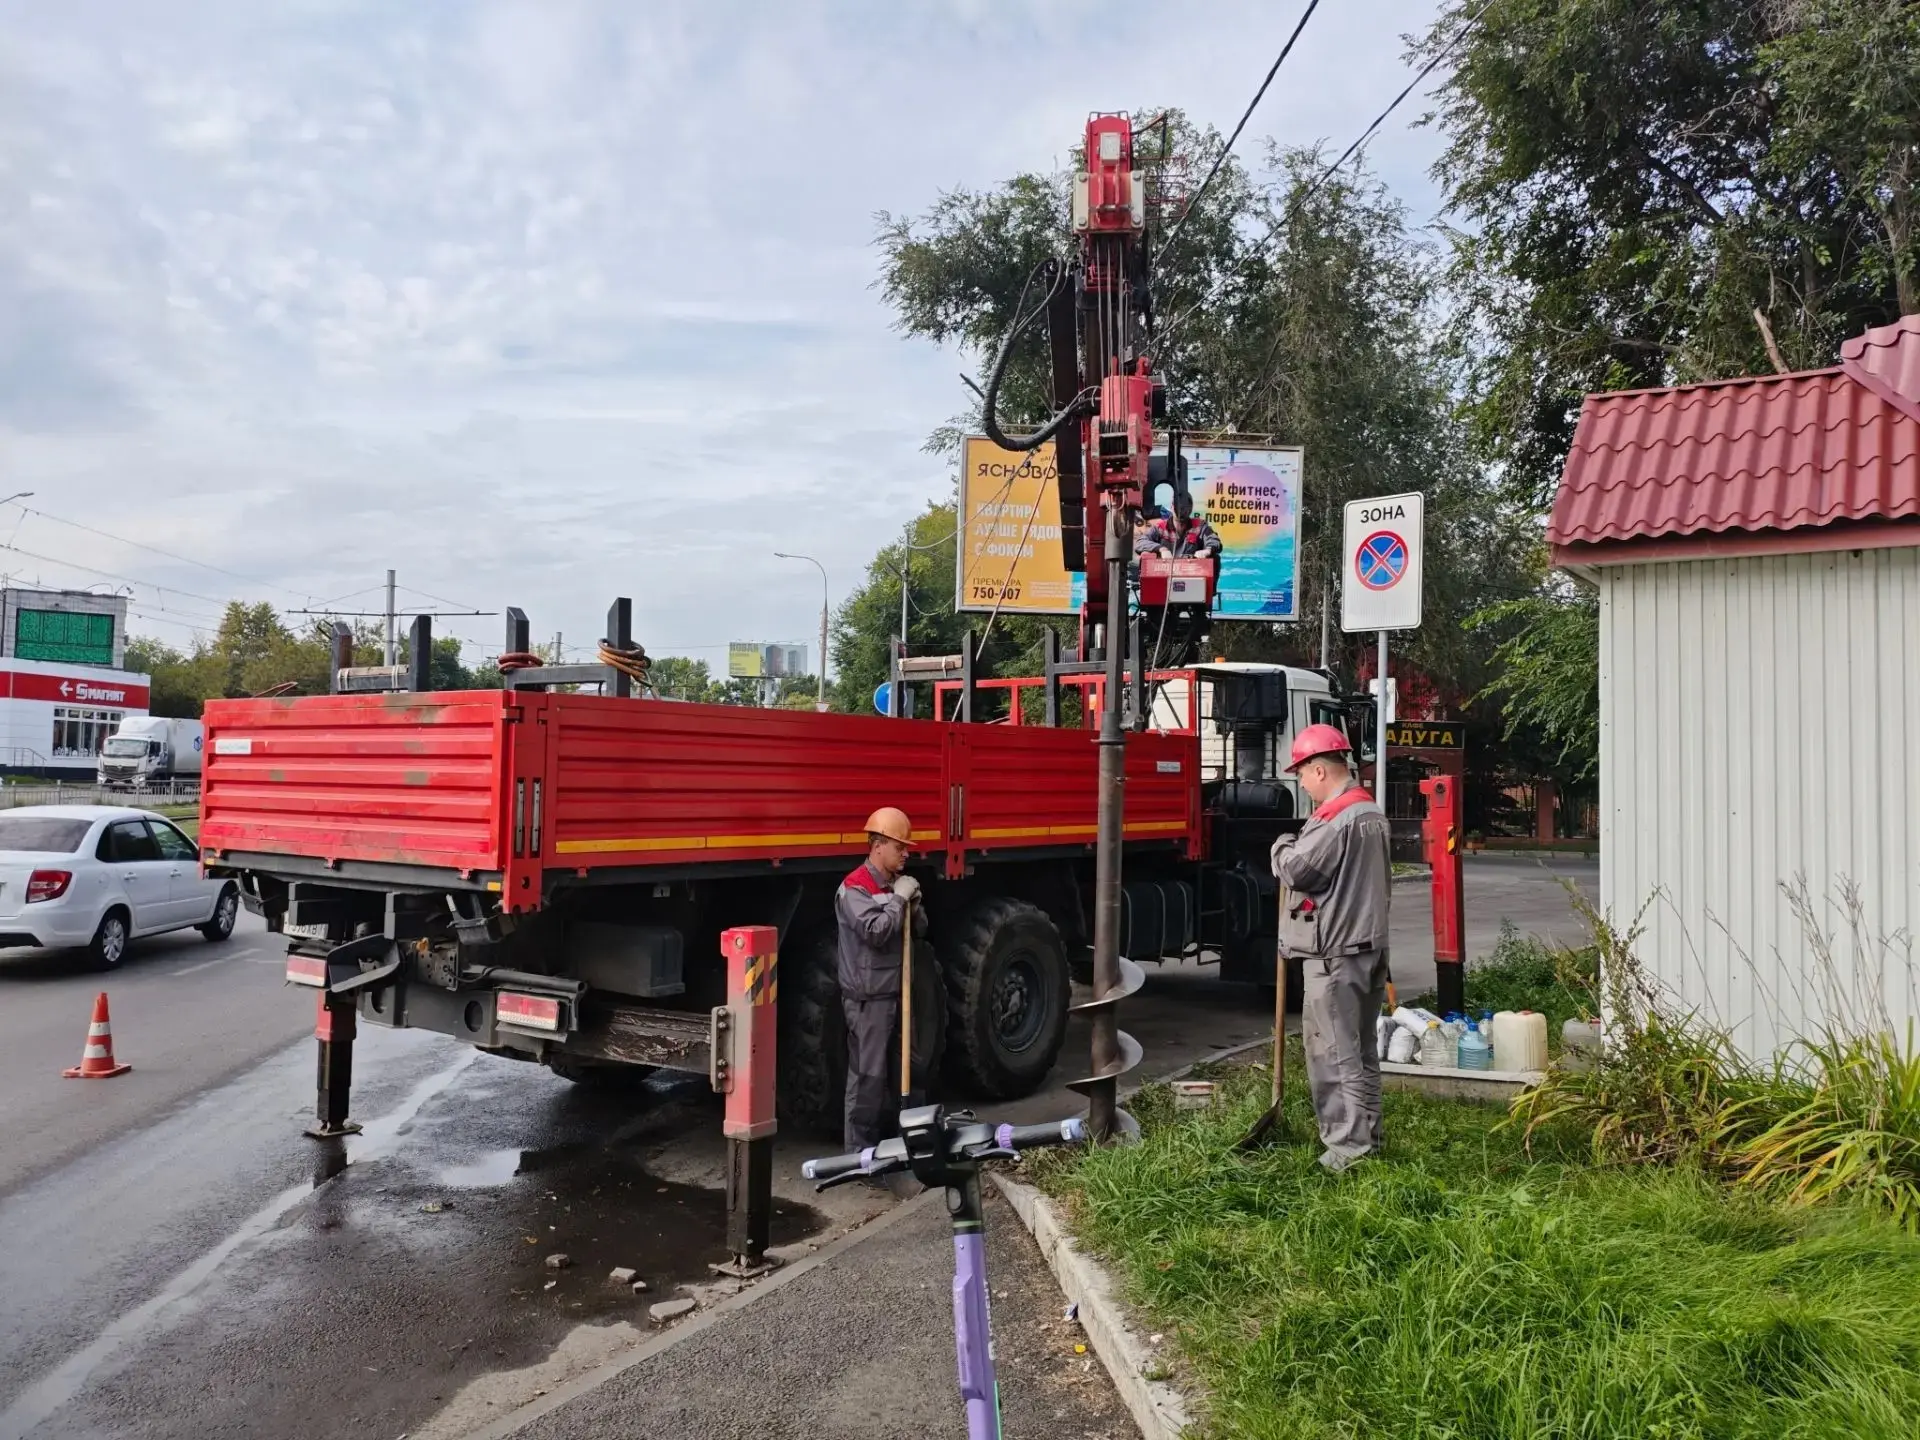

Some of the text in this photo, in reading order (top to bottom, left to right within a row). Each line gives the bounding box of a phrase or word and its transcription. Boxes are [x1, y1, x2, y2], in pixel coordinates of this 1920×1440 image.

[1216, 482, 1280, 499] И фитнес,
[976, 503, 1040, 518] КВАРТИРА
[1207, 499, 1215, 509] и
[1219, 497, 1270, 511] бассейн
[1206, 513, 1236, 526] паре
[1240, 514, 1279, 525] шагов
[1360, 505, 1405, 523] ЗОНА
[975, 522, 1017, 538] ЛУЧШЕ
[974, 542, 1034, 558] С ФОКОМ
[1386, 729, 1454, 746] АДУГА
